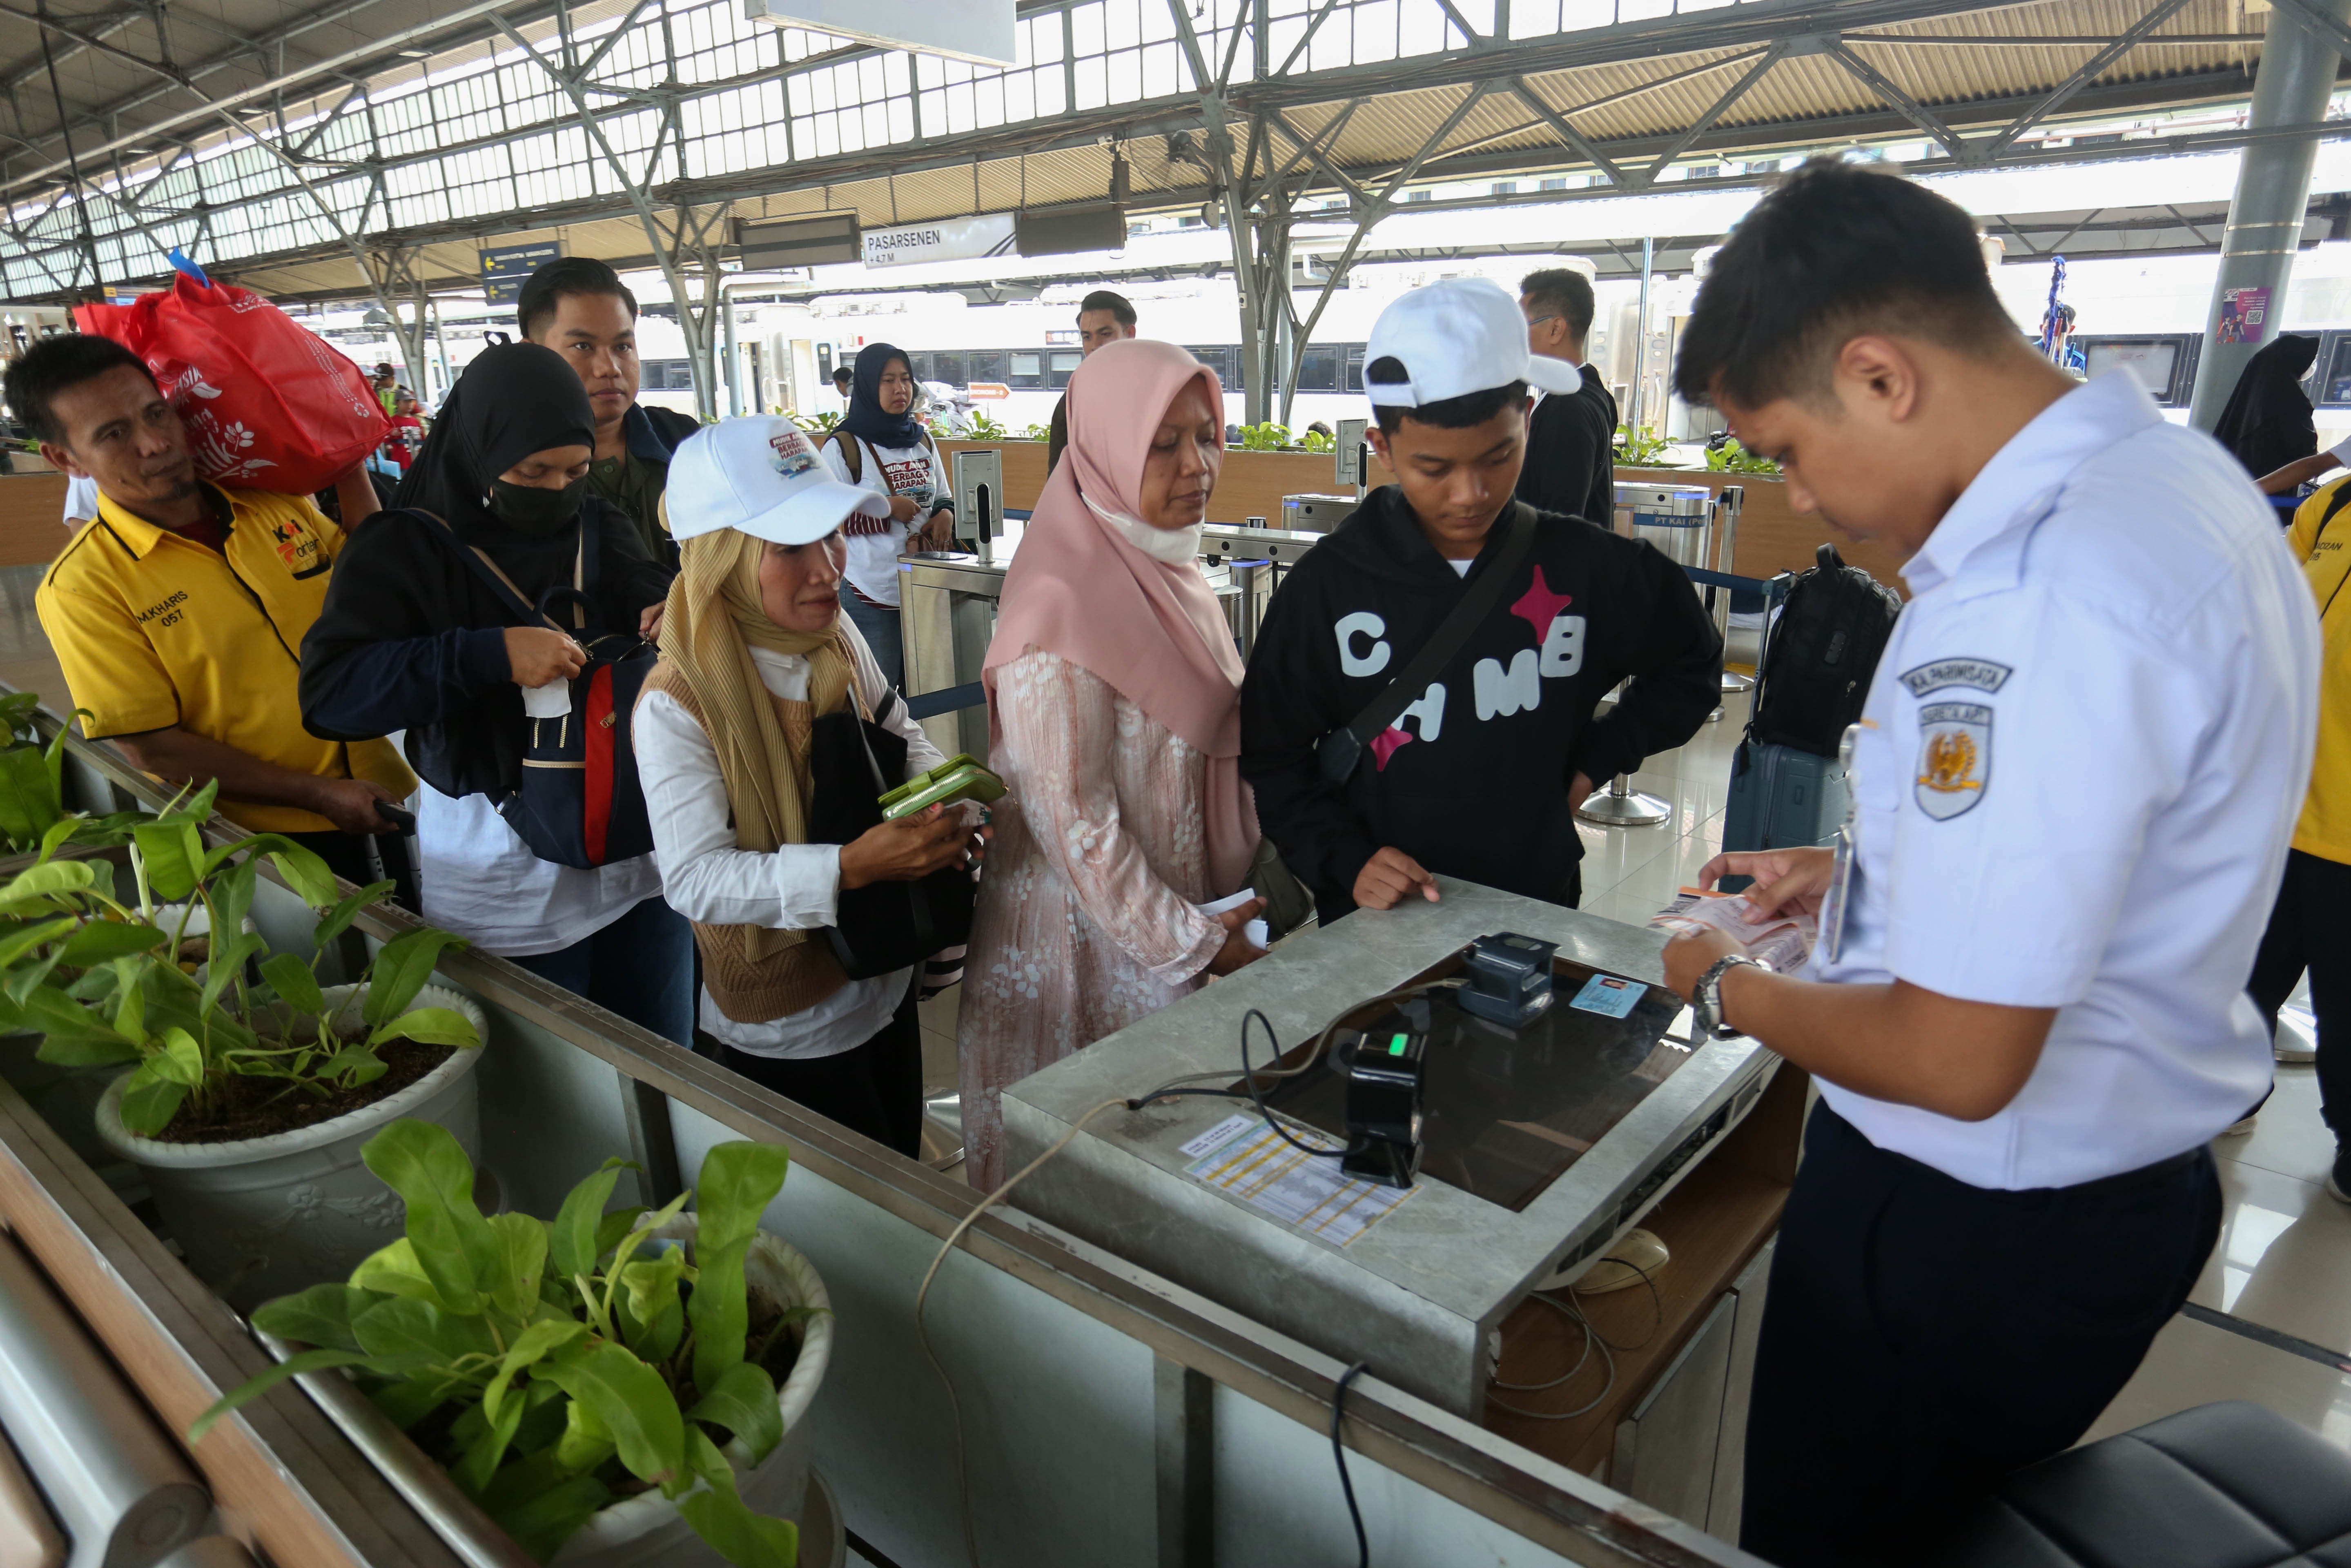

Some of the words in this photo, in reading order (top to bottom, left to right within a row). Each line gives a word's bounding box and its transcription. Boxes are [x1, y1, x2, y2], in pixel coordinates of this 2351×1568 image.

[868, 230, 941, 250] PASARSENEN
[887, 253, 895, 262] M
[893, 478, 926, 490] ARAPAN
[136, 591, 188, 624] M.KHARIS
[161, 609, 183, 627] 057
